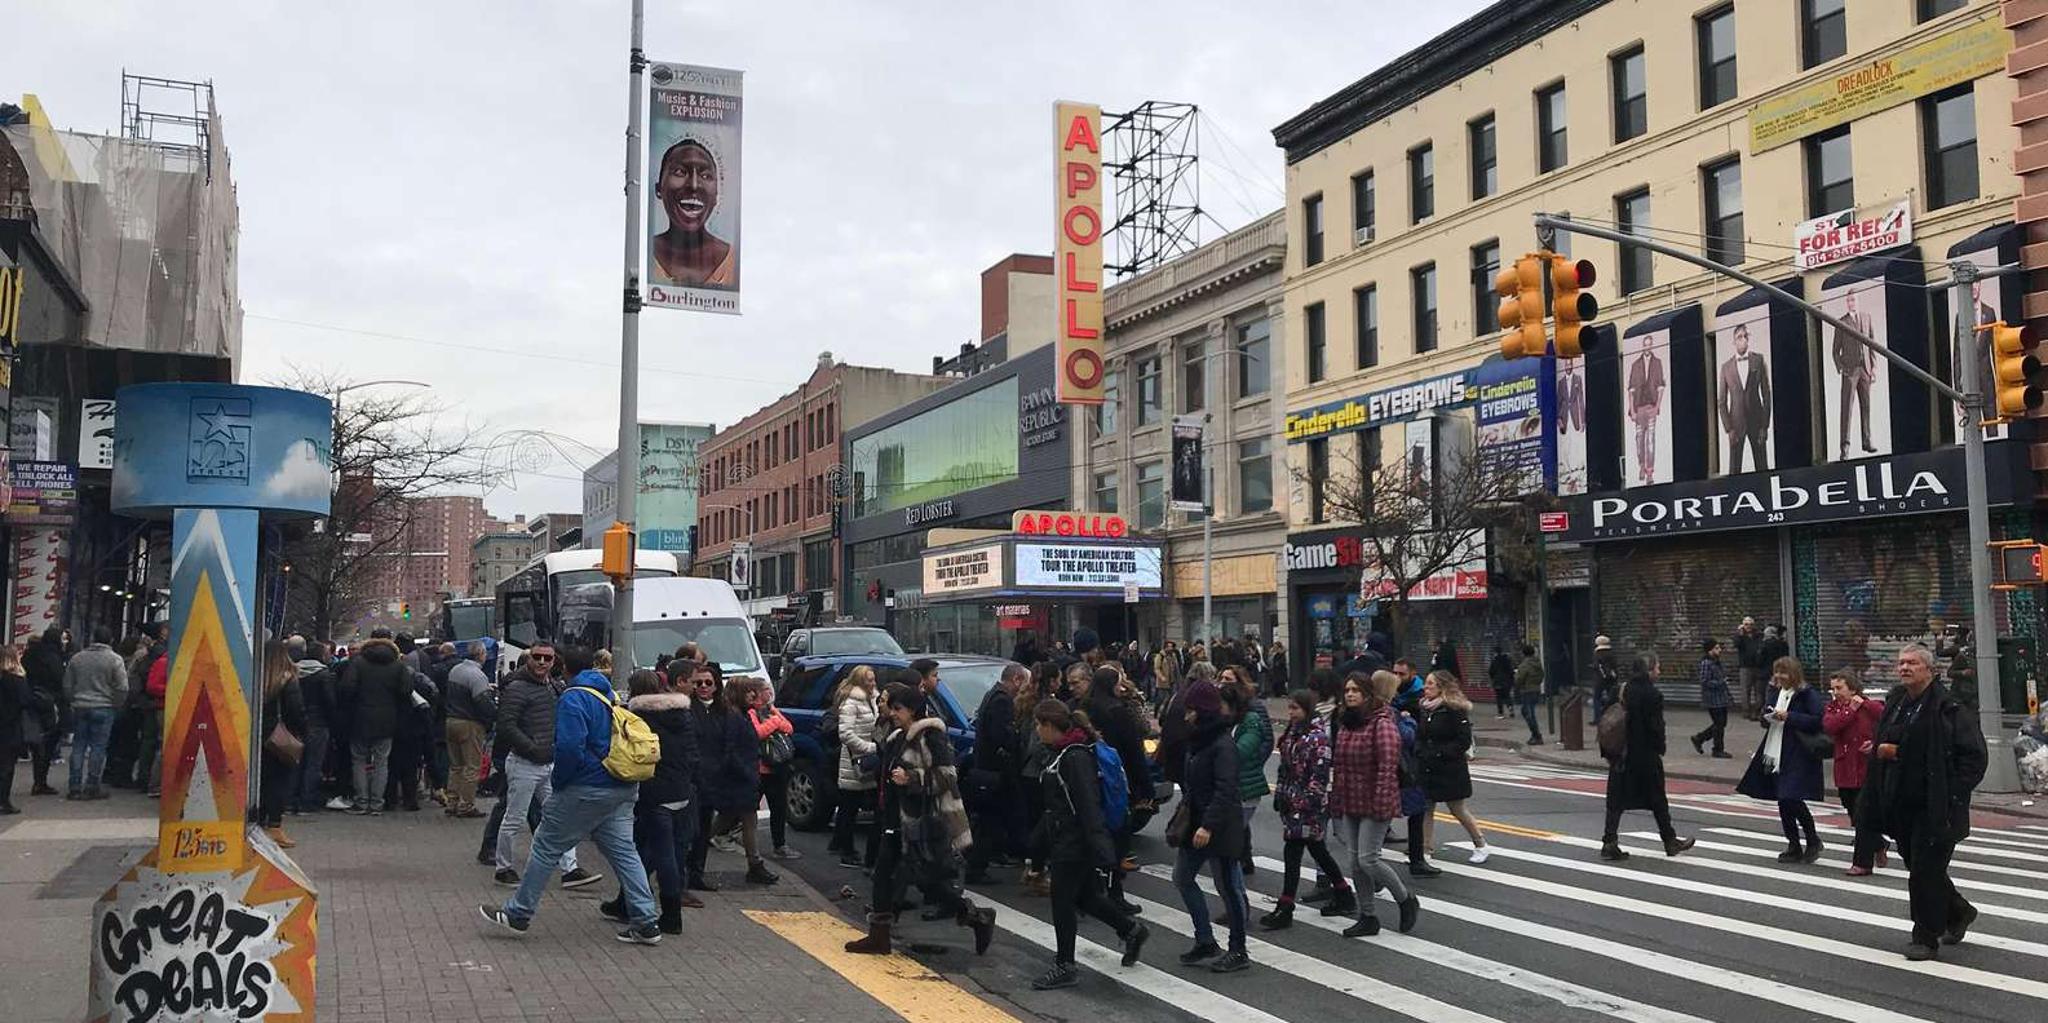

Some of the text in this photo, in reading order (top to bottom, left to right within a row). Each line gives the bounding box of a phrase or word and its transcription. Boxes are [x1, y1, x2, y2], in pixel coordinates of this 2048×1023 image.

[1837, 61, 1893, 95] DREADLOCK
[658, 92, 736, 110] Music & Fashion
[671, 105, 723, 120] EXPLOSION
[1064, 115, 1103, 391] APOLLO
[1800, 229, 1841, 255] FOR
[651, 286, 735, 311] Burlington
[1480, 376, 1537, 401] Cinderella
[1285, 374, 1465, 438] Cinderella EYEBROWS
[1481, 392, 1537, 419] EYEBROWS
[1021, 405, 1063, 433] REPUBLIC
[192, 440, 246, 468] 125
[666, 438, 695, 449] DSW
[16, 463, 67, 472] WE REPAIR
[35, 481, 72, 489] PHONES
[905, 500, 953, 526] RED LOBSTER
[1767, 512, 1785, 522] 243
[1858, 497, 1950, 513] SHOES
[1019, 513, 1126, 538] APOLLO
[1594, 520, 1703, 537] MENSWEAR
[1042, 549, 1135, 560] THE SOUL OF AMERICAN CULTURE
[2032, 553, 2042, 577] 9
[1041, 560, 1136, 574] TOUR THE APOLLO THEATER
